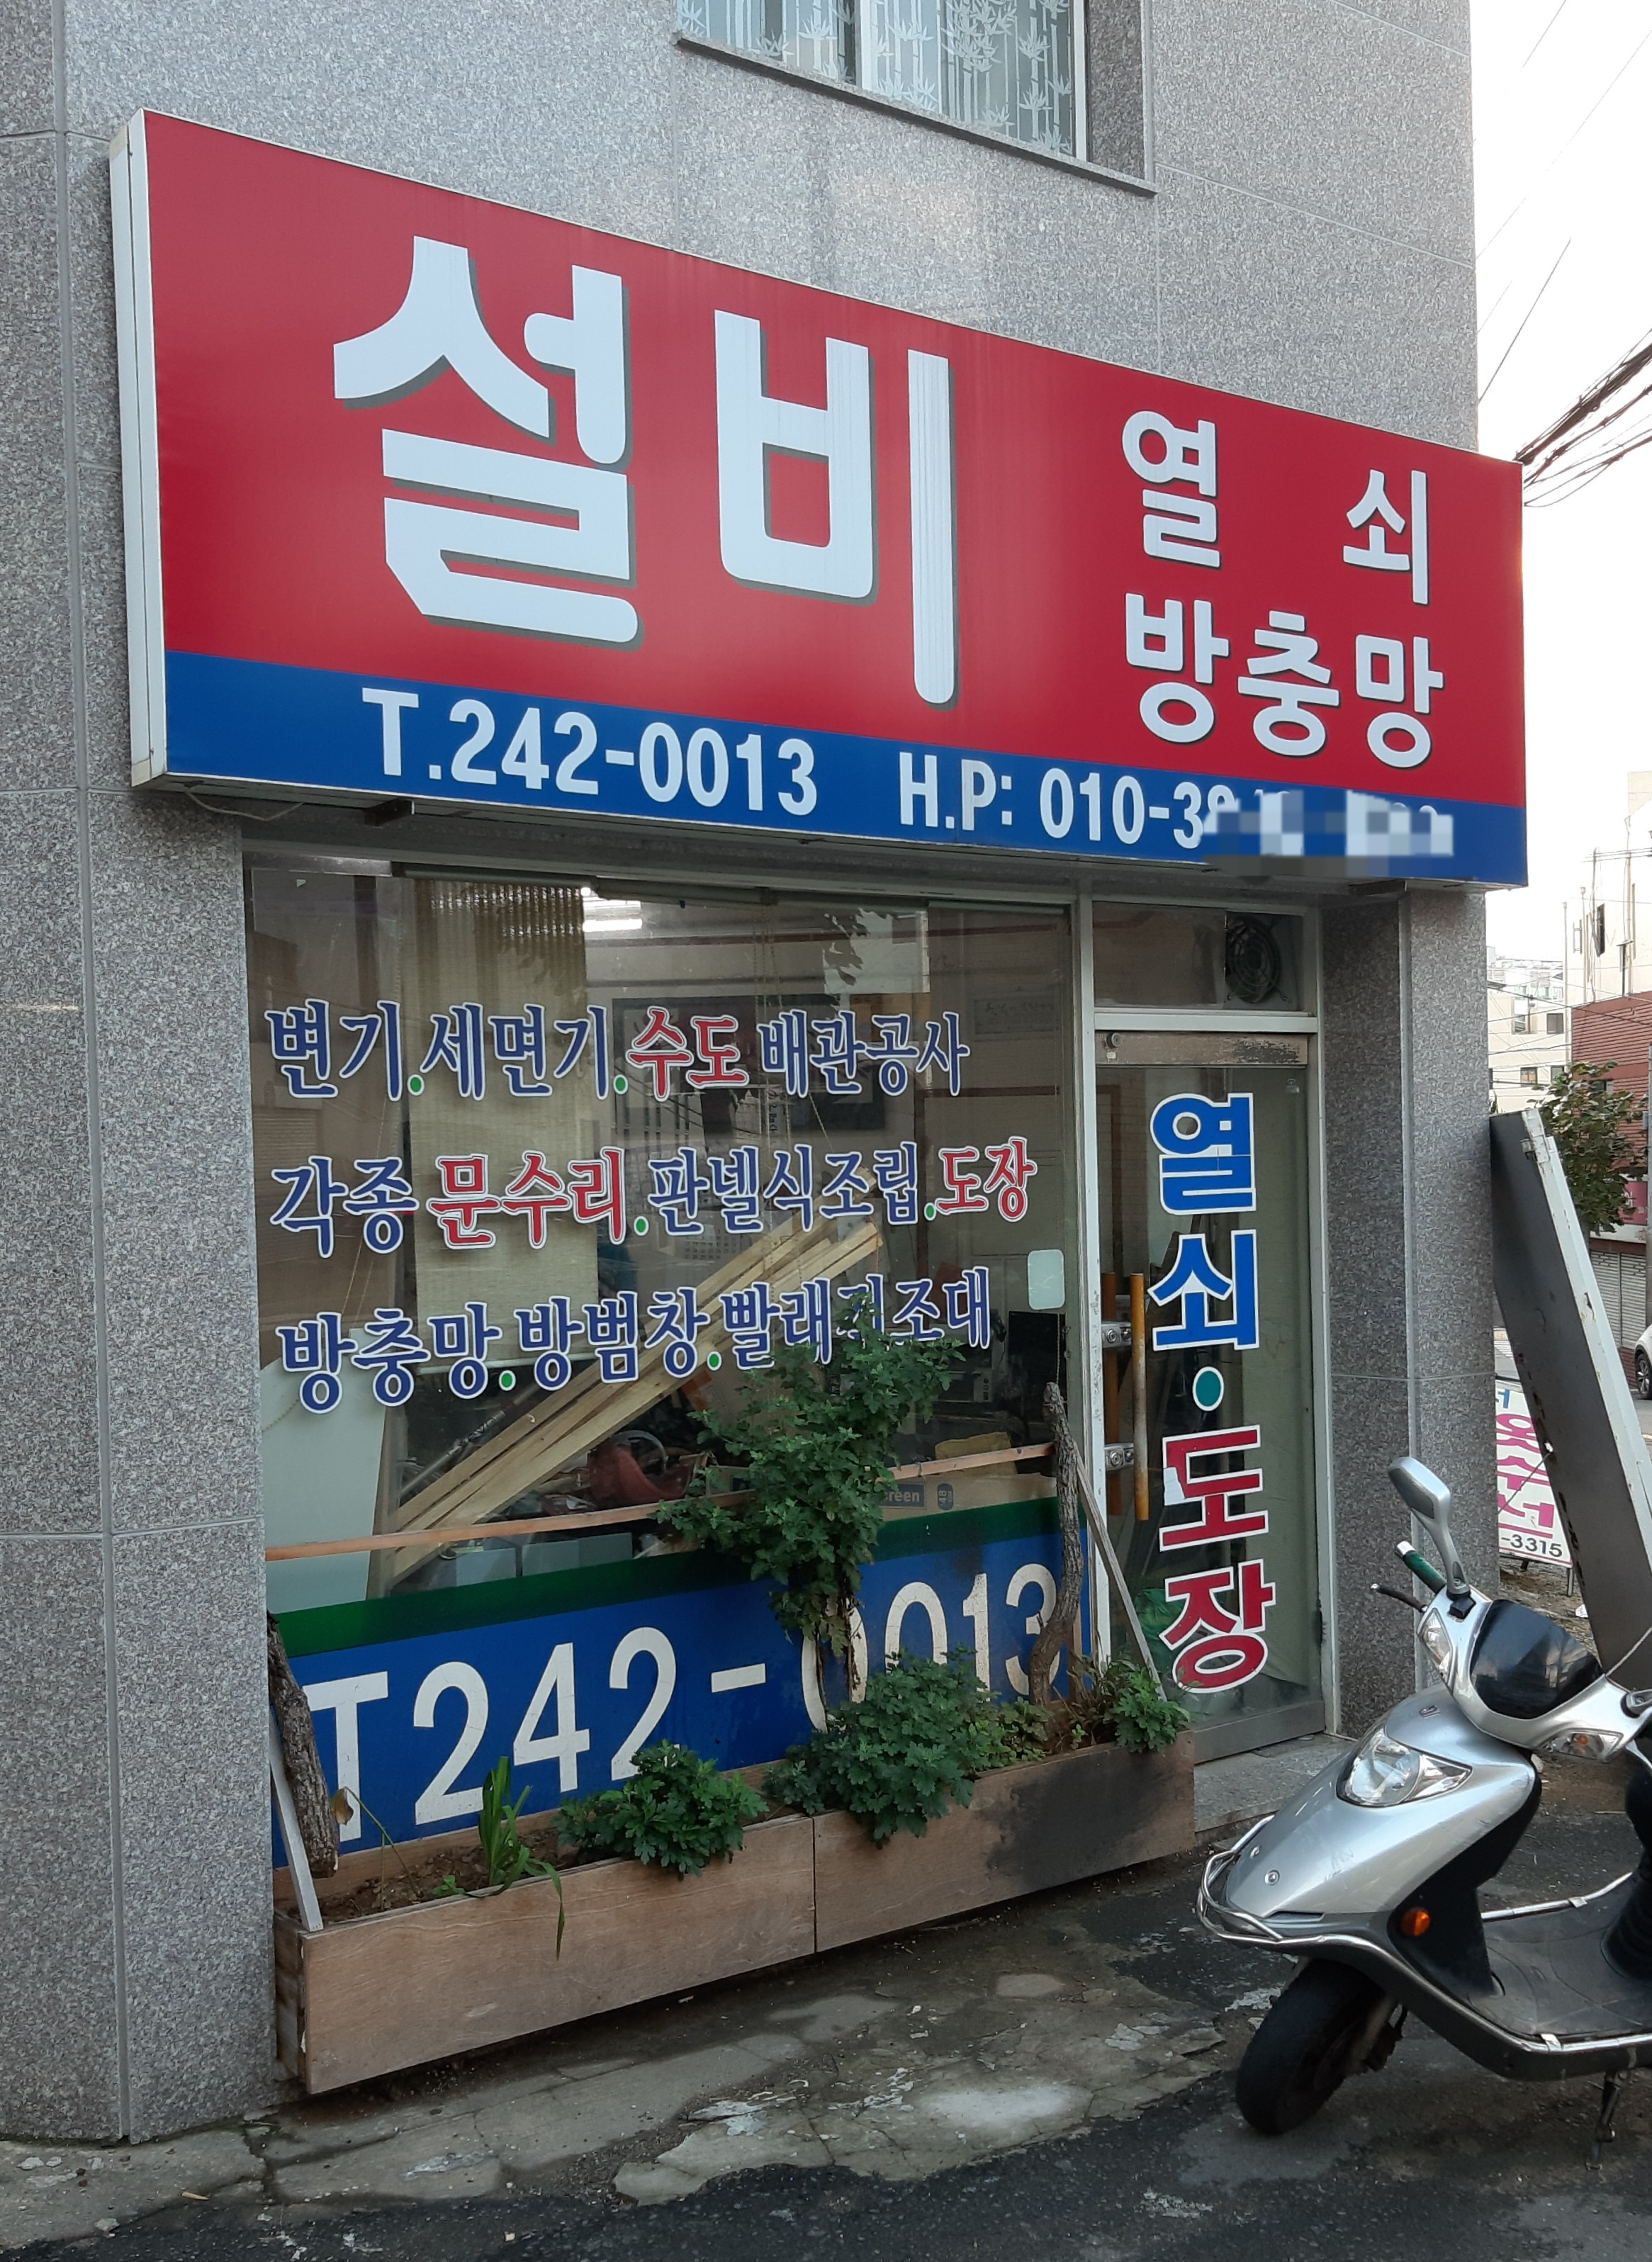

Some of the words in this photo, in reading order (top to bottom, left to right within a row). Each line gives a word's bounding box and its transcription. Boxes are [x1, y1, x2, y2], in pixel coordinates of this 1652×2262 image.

[333, 235, 955, 708] 설비
[361, 687, 819, 816] T.242-0013
[1125, 592, 1445, 769] 방충망
[757, 1008, 970, 1098] 배관공사
[269, 1154, 420, 1259] 각종
[1147, 1091, 1262, 1352] 열쇠
[1157, 1423, 1277, 1694] 도장
